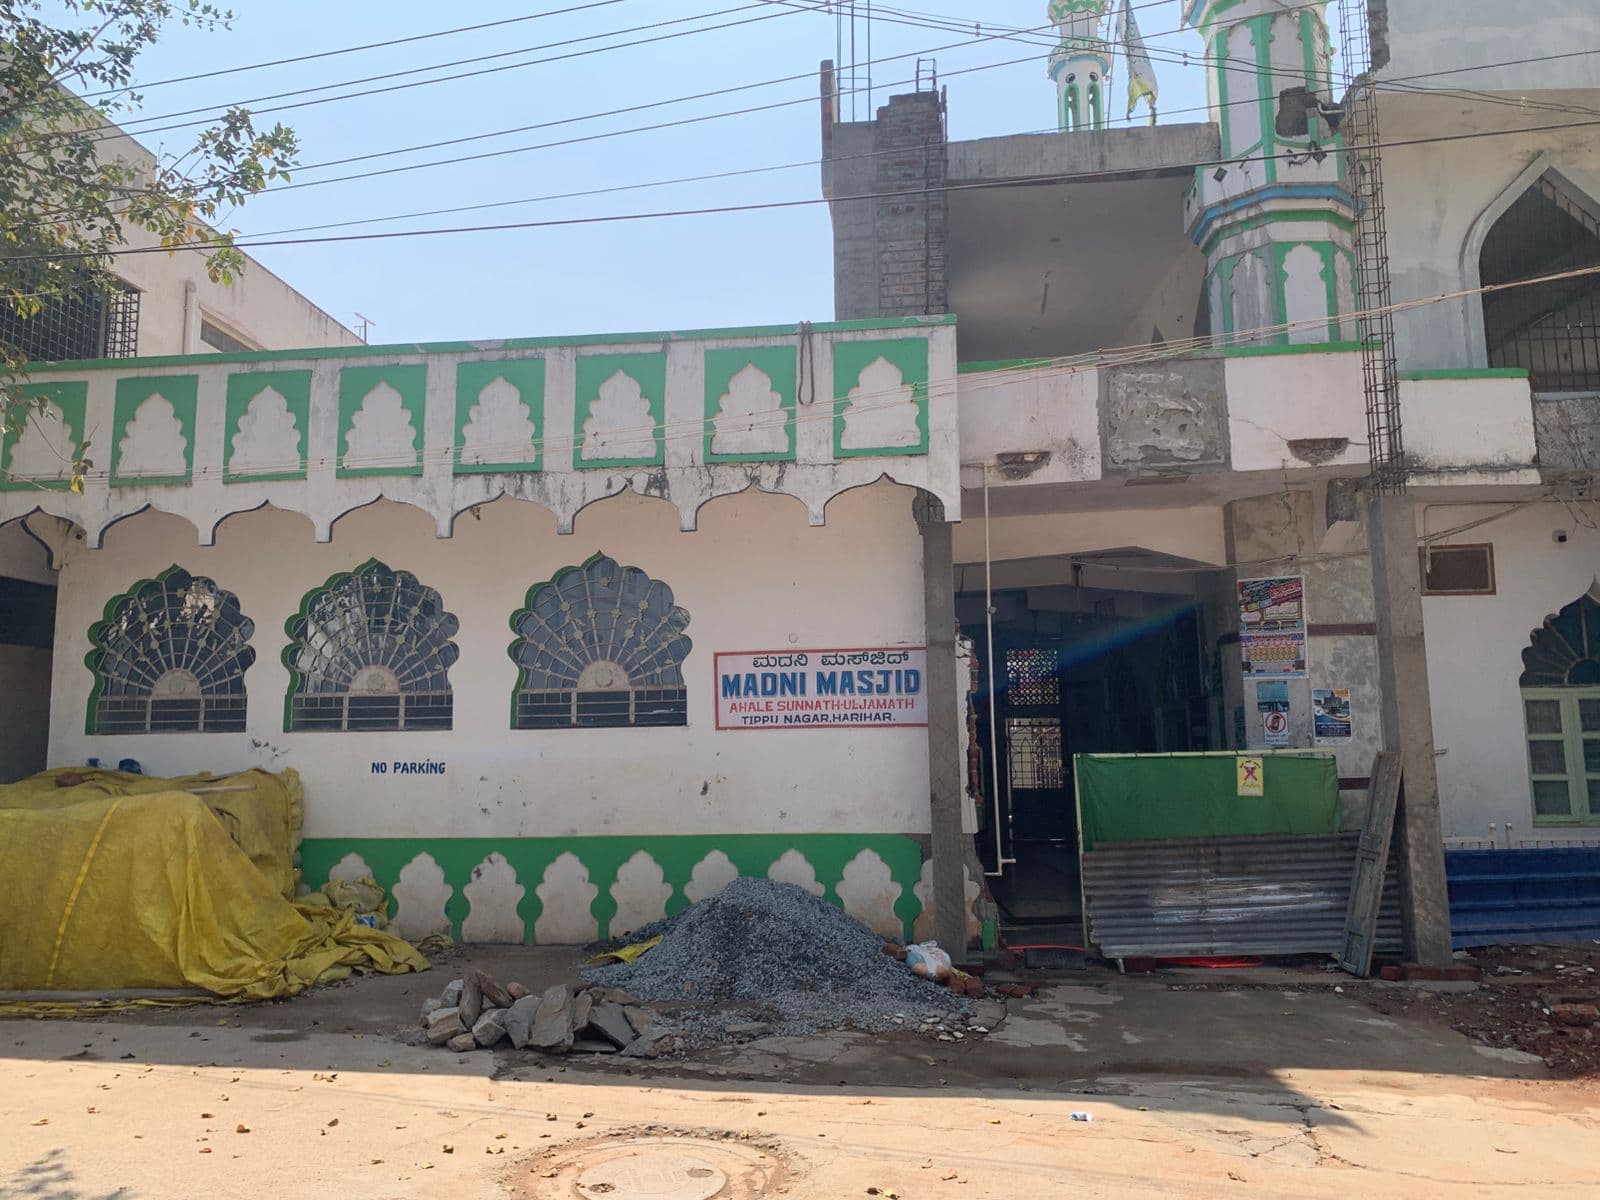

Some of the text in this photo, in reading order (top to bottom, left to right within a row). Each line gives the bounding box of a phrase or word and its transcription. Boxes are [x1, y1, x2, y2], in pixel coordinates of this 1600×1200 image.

[721, 669, 920, 698] MADNI MASJID
[729, 701, 778, 713] AHALE
[741, 715, 778, 725] TIPPU
[371, 762, 387, 774] NO
